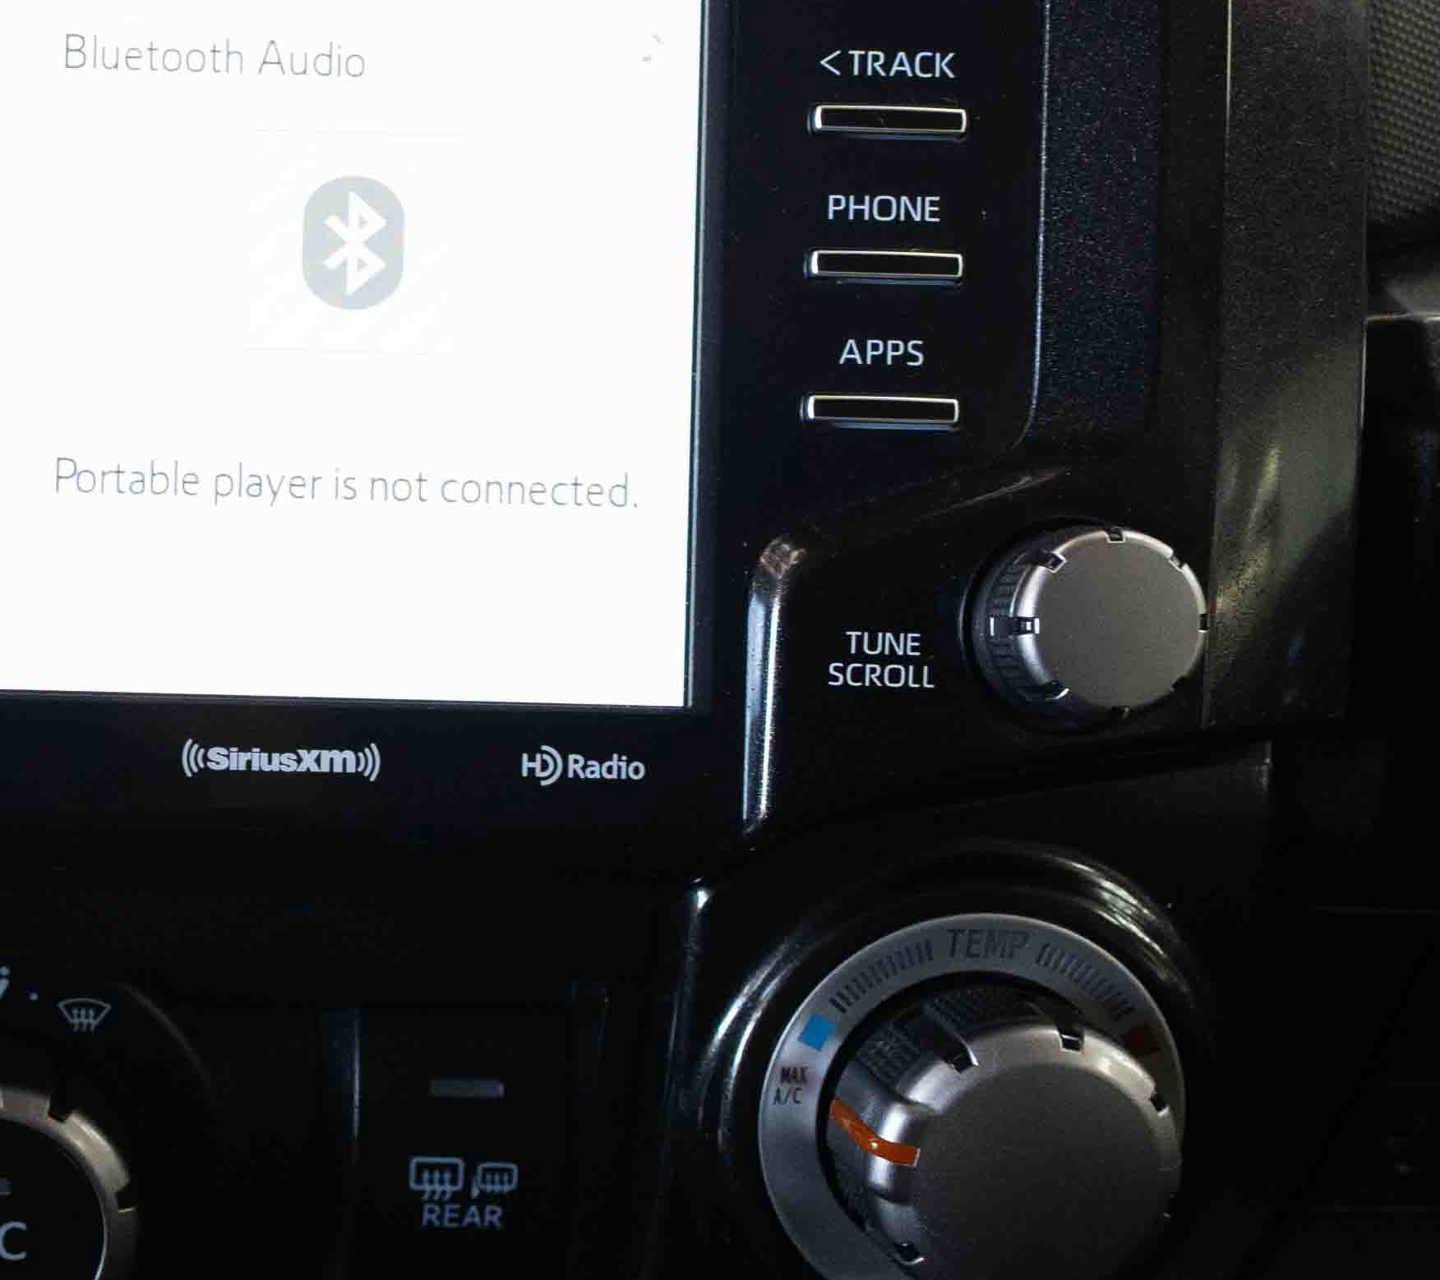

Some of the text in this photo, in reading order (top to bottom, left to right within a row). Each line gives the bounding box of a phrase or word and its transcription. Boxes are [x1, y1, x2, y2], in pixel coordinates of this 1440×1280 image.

[62, 33, 367, 78] Bluetooth Audio
[828, 195, 941, 222] PHONE
[839, 339, 925, 367] APPS
[55, 458, 639, 509] Portable player is not connected.
[845, 632, 920, 654] TUNE
[828, 663, 934, 689] SCROLL
[567, 753, 645, 780] Radio
[947, 928, 1029, 962] TEMP
[779, 1066, 808, 1085] MAX
[773, 1086, 802, 1106] A/C
[422, 1203, 503, 1229] REAR
